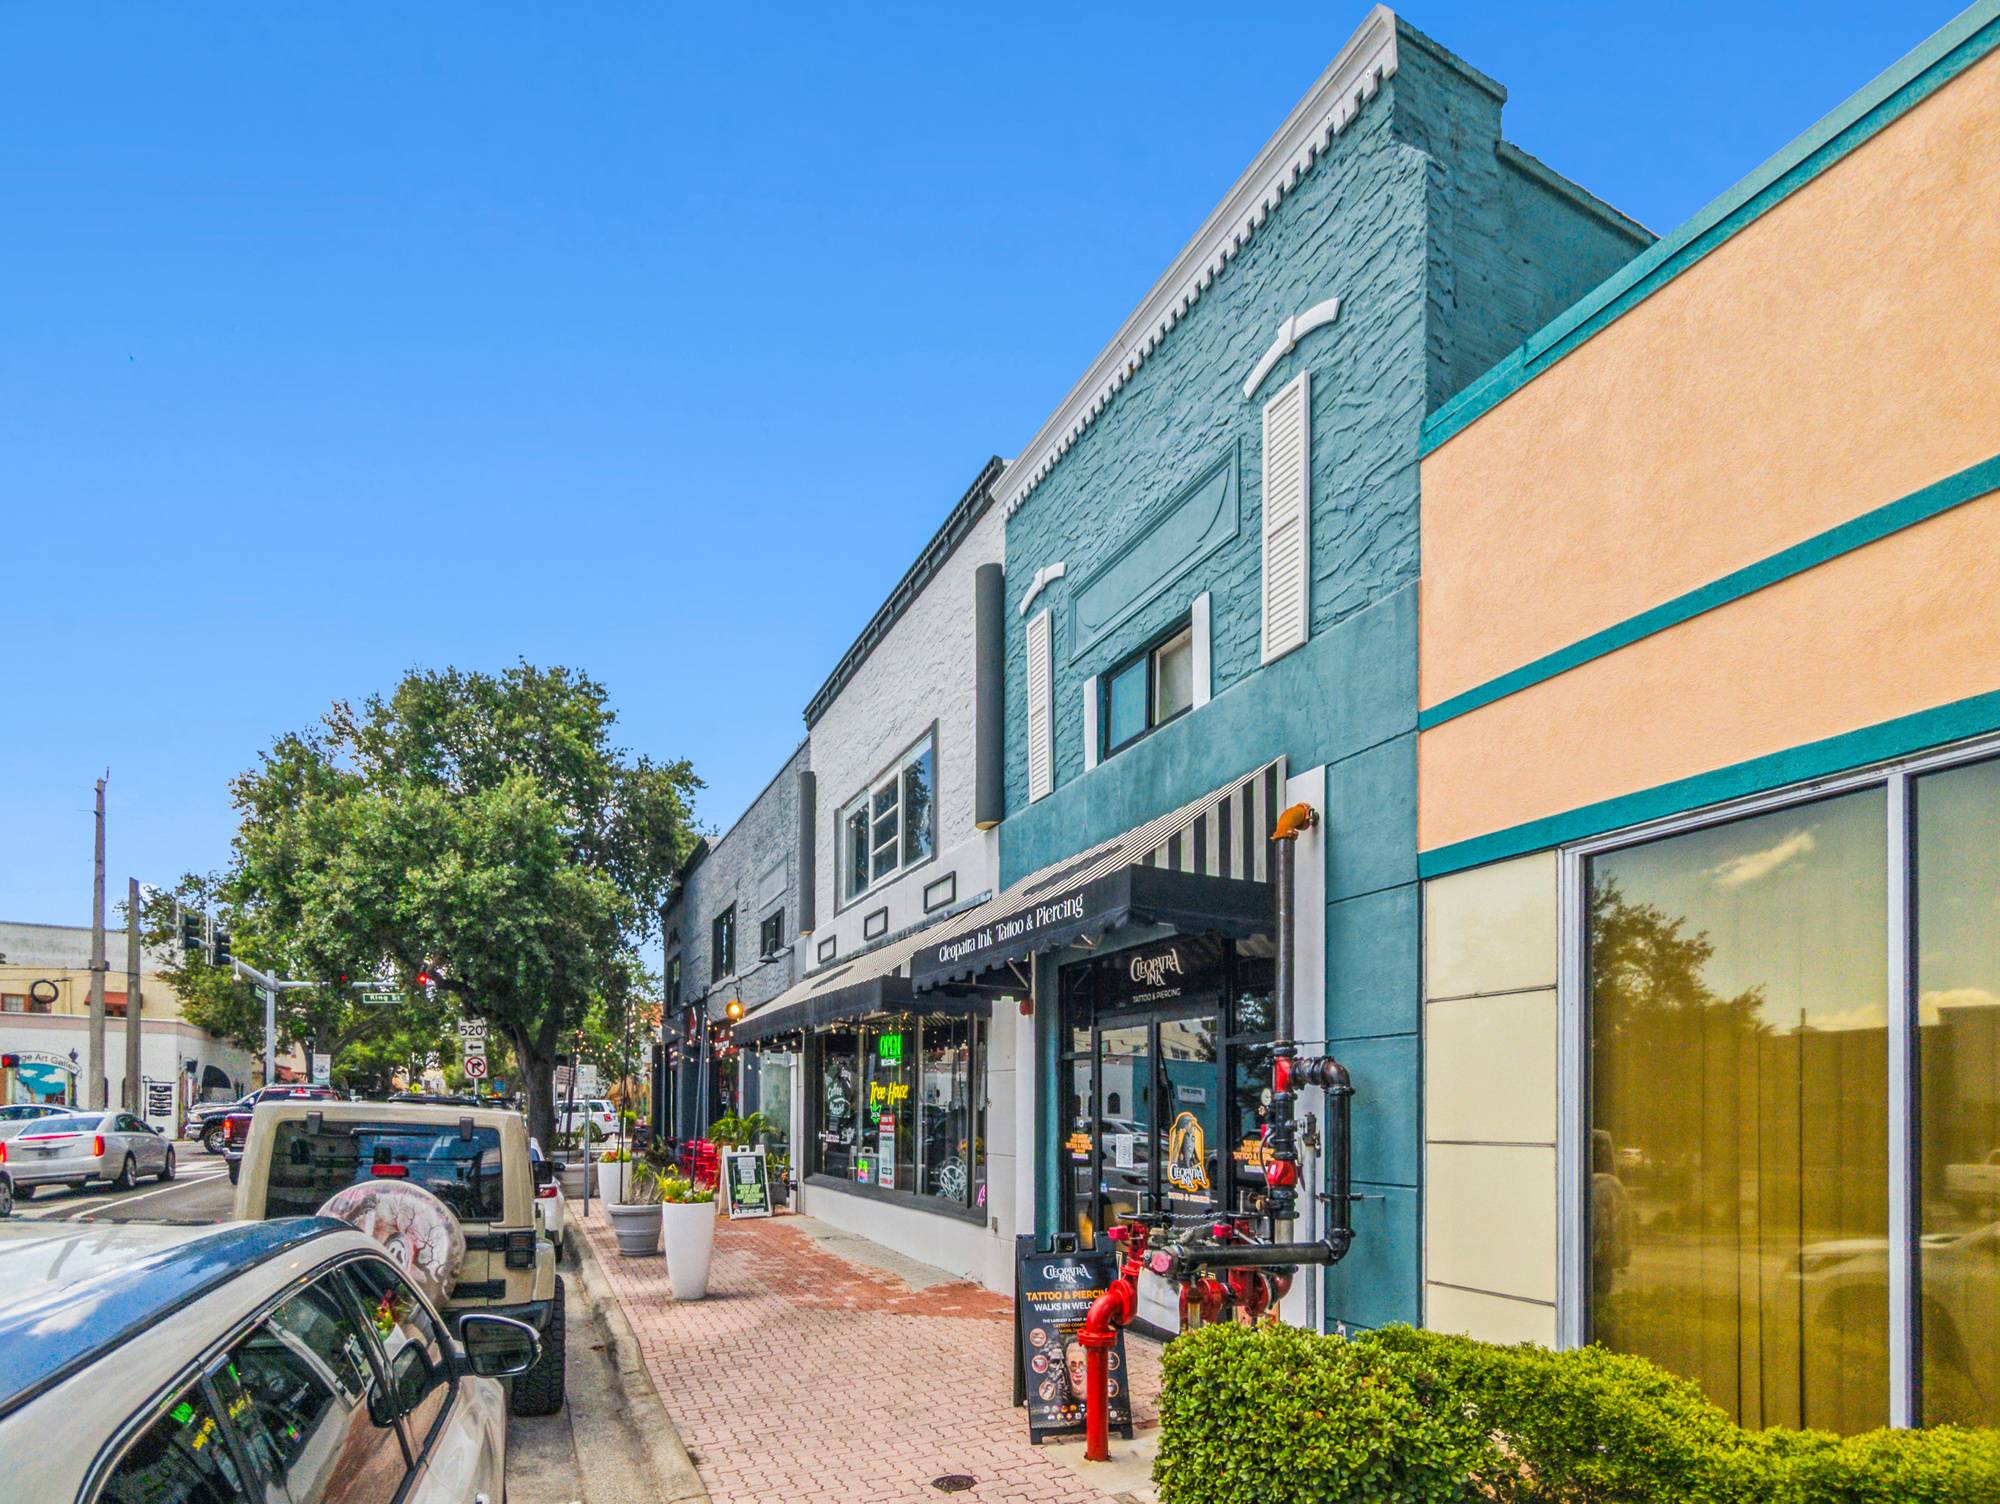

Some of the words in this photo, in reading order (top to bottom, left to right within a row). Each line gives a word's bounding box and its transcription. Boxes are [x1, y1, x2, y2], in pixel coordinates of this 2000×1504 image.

[939, 937, 976, 962] Cleopatra
[977, 928, 993, 948] Ink
[995, 919, 1024, 942] Tattoo
[1026, 913, 1033, 931] &
[1036, 893, 1084, 928] Piercing
[1132, 993, 1152, 1003] TATTOO
[1156, 987, 1181, 999] PIERCING
[460, 1025, 484, 1036] 520
[880, 1034, 903, 1058] OPEN
[35, 1053, 49, 1061] Art
[869, 1081, 886, 1105] Tree
[887, 1081, 909, 1105] House
[1026, 1291, 1062, 1302] TATTOO
[1063, 1291, 1071, 1301] &
[1072, 1288, 1108, 1300] PIERCIN
[1034, 1303, 1062, 1312] WALKS
[1062, 1302, 1071, 1310] IN
[1072, 1301, 1094, 1310] WELC
